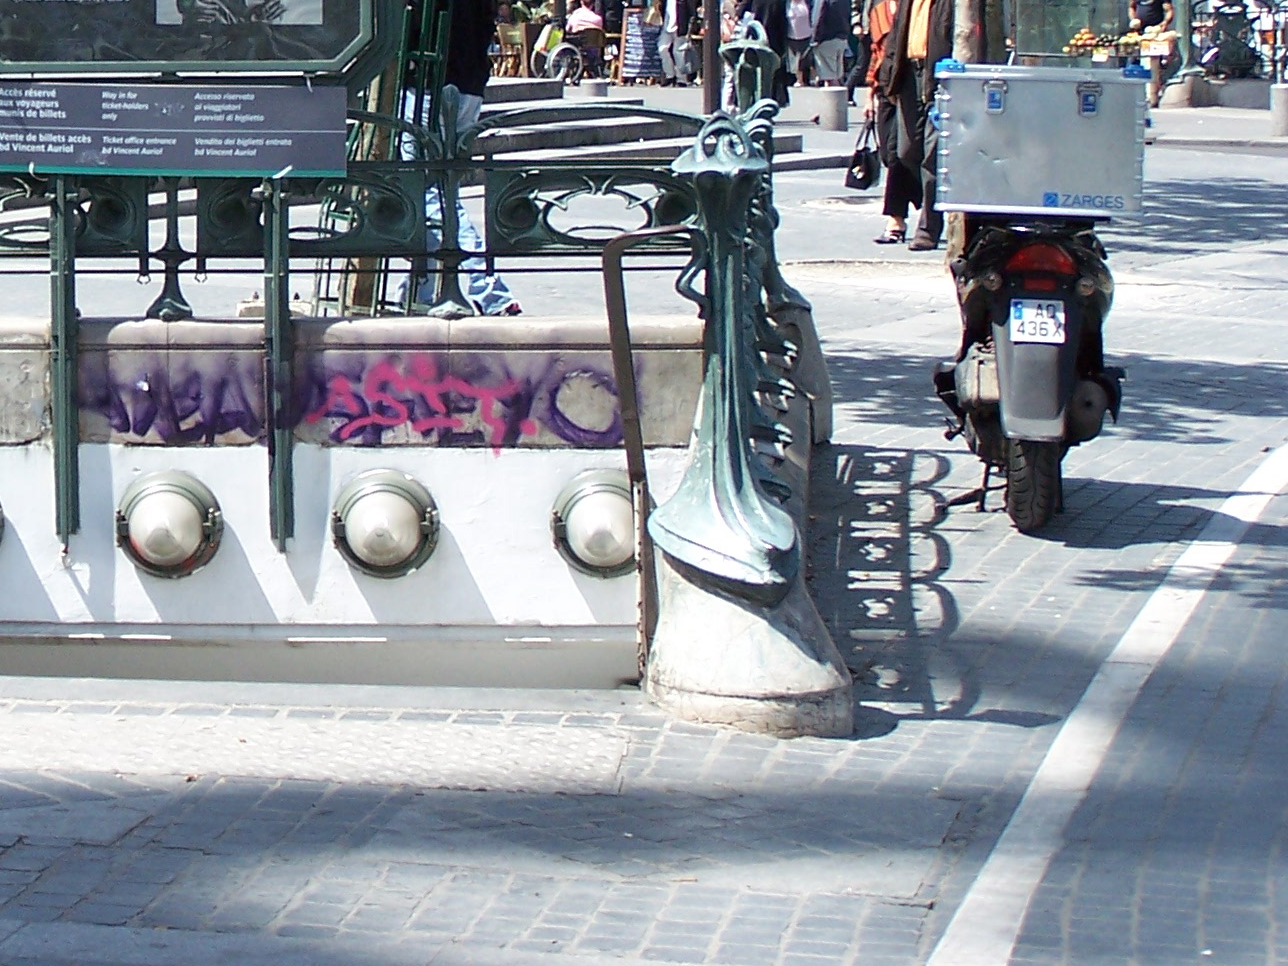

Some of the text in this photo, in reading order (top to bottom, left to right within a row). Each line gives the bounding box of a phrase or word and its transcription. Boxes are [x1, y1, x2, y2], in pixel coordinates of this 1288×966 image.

[24, 87, 57, 99] réservé
[102, 91, 138, 100] Way in for
[15, 99, 59, 109] voyageurs
[26, 109, 38, 118] de
[39, 109, 67, 119] billets
[101, 112, 118, 122] only
[26, 133, 38, 142] de
[39, 133, 66, 143] billets
[67, 134, 92, 144] accès
[102, 136, 124, 144] Ticket
[124, 137, 144, 145] office
[12, 144, 46, 153] Vincent
[47, 144, 74, 153] Auriol
[102, 146, 163, 156] bd Vincent Auriol
[205, 148, 233, 156] Vincent
[1061, 194, 1125, 209] ZARGES
[1017, 321, 1049, 337] 436
